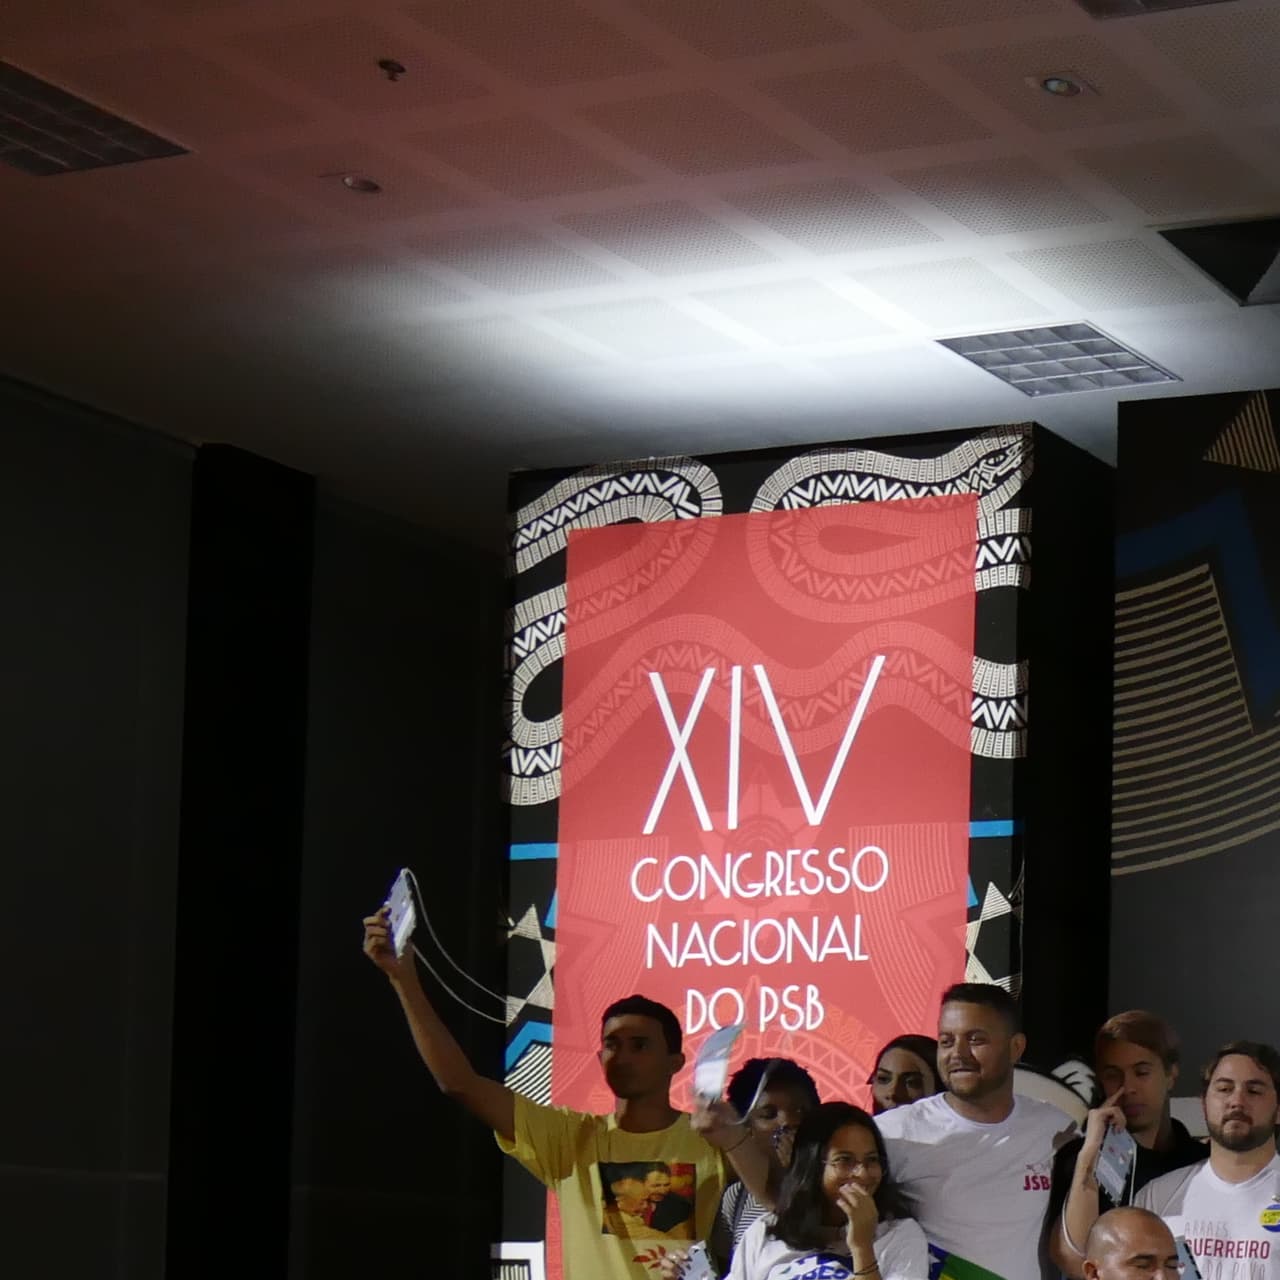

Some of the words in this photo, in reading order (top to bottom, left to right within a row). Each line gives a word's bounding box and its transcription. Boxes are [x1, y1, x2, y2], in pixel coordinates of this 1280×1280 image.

[643, 656, 885, 834] XIV
[631, 846, 889, 902] CONGRESSO
[646, 915, 869, 968] NACIONAL
[686, 988, 743, 1034] DO
[760, 984, 825, 1032] PSB
[1023, 1175, 1050, 1191] JSB
